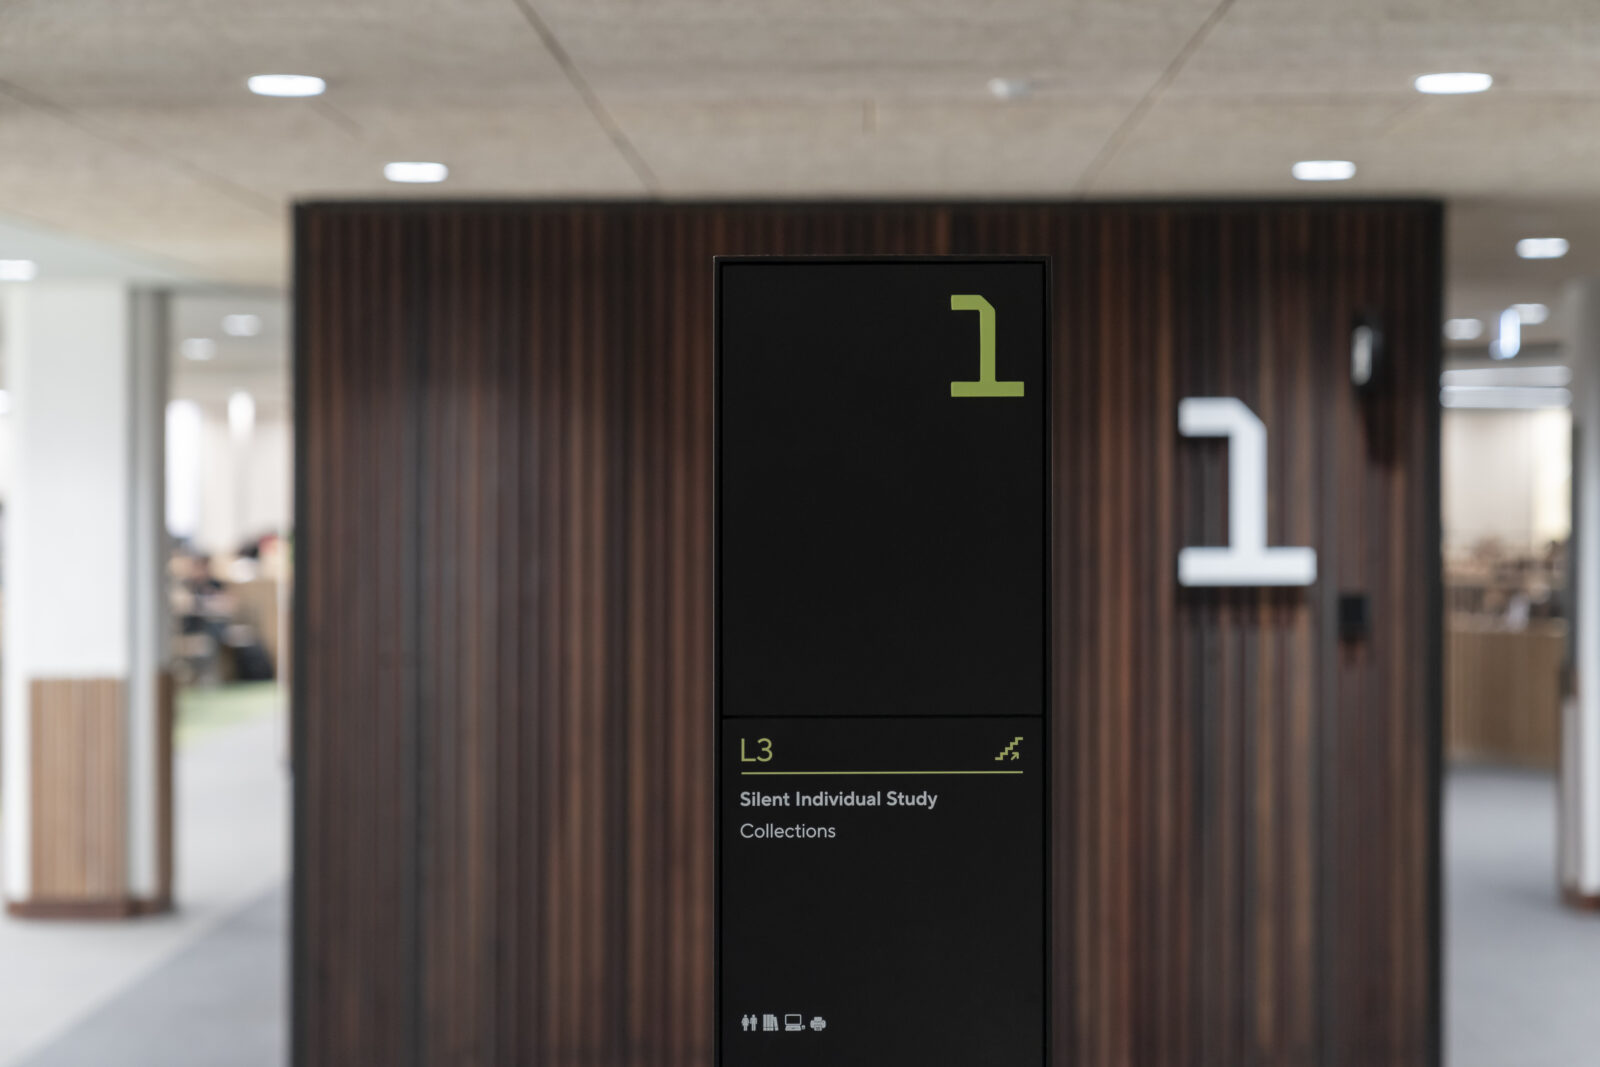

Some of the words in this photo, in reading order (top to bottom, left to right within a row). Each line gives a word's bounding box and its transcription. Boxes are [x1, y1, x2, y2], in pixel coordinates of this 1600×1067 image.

[950, 294, 1025, 398] 1
[1178, 397, 1318, 587] 1
[740, 737, 773, 763] L3
[739, 790, 791, 807] Silent
[795, 790, 881, 807] Individual
[886, 790, 938, 810] Study
[739, 822, 837, 840] Collections
